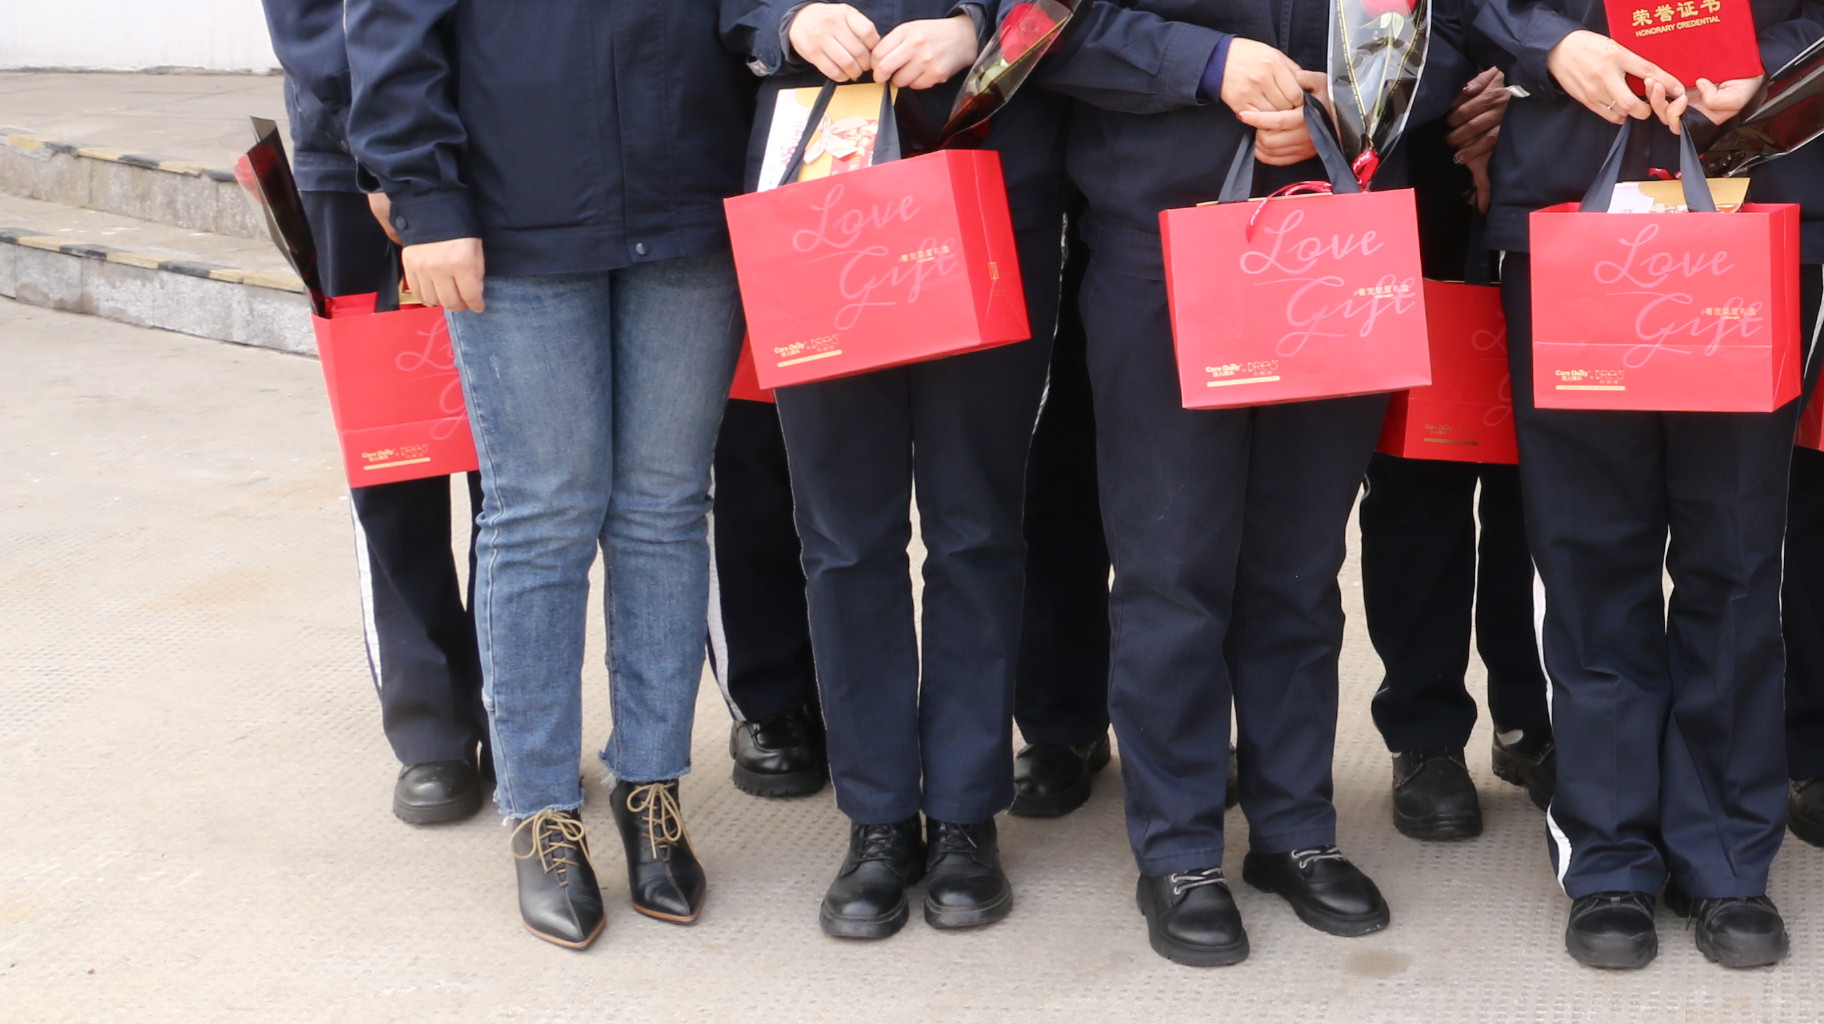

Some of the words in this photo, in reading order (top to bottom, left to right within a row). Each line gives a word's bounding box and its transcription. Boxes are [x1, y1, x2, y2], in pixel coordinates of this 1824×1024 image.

[1635, 23, 1675, 37] HONORARY
[1676, 15, 1721, 30] CREDENTIAL
[792, 184, 922, 251] Love
[1239, 209, 1384, 274] Love
[808, 238, 957, 330] Gift
[1593, 223, 1735, 288] Love
[1254, 274, 1416, 357] Gift
[1605, 291, 1763, 368] Gift
